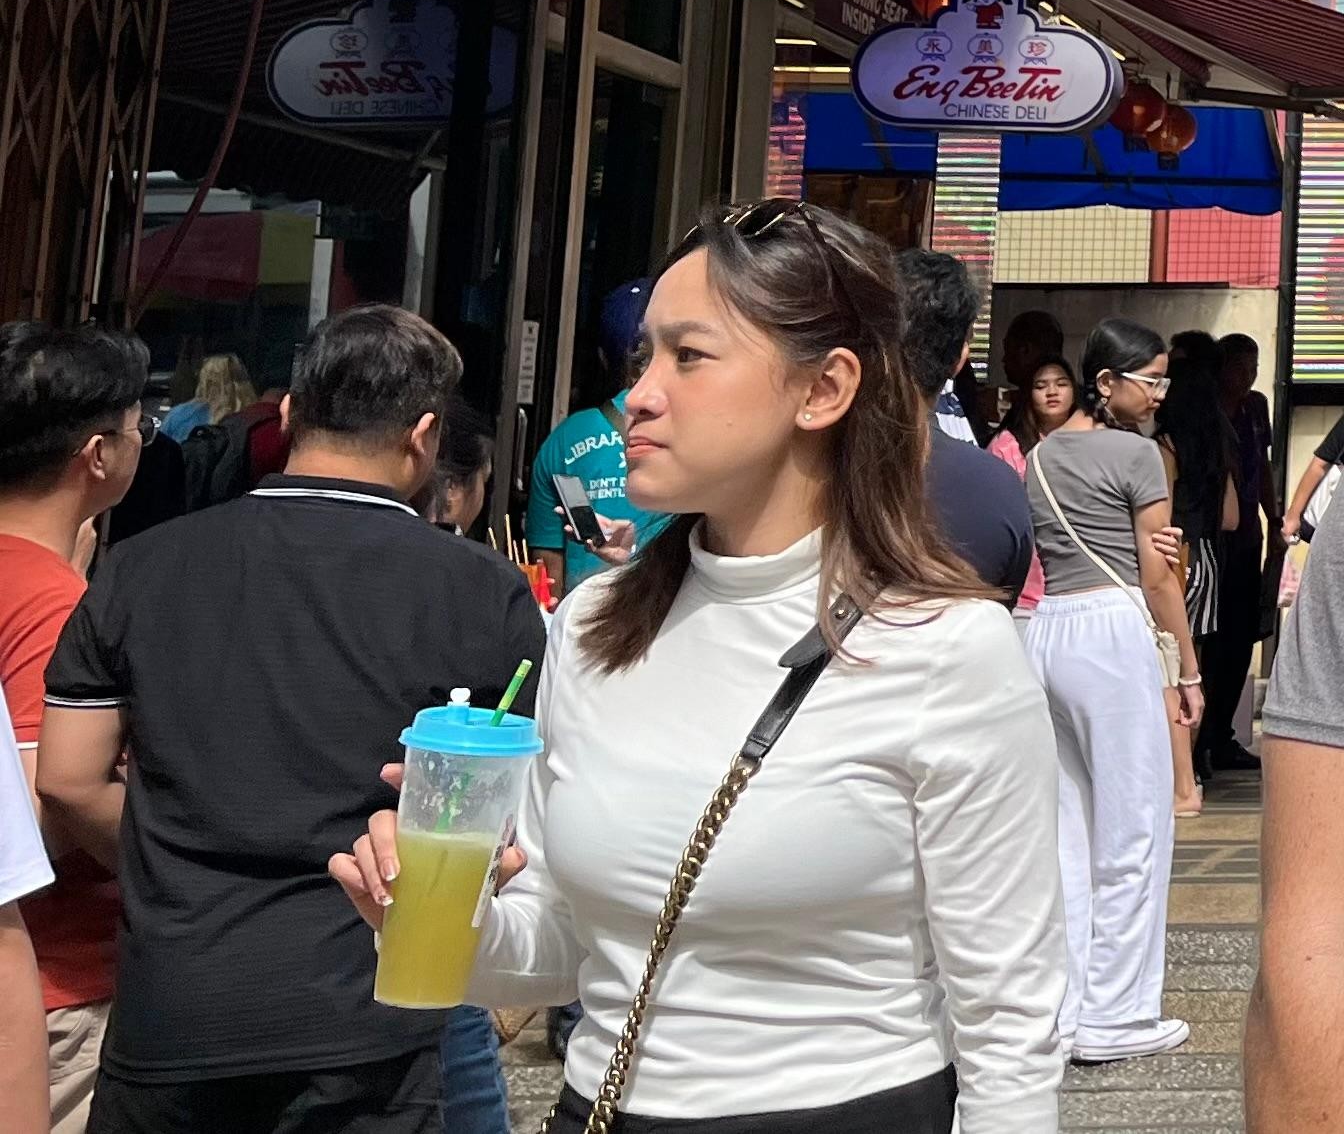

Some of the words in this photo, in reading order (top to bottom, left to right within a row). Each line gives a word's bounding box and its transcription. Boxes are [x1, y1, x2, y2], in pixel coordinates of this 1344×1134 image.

[944, 103, 1010, 120] CHINESE
[1015, 104, 1047, 120] DELI
[564, 431, 625, 465] LIBRAR
